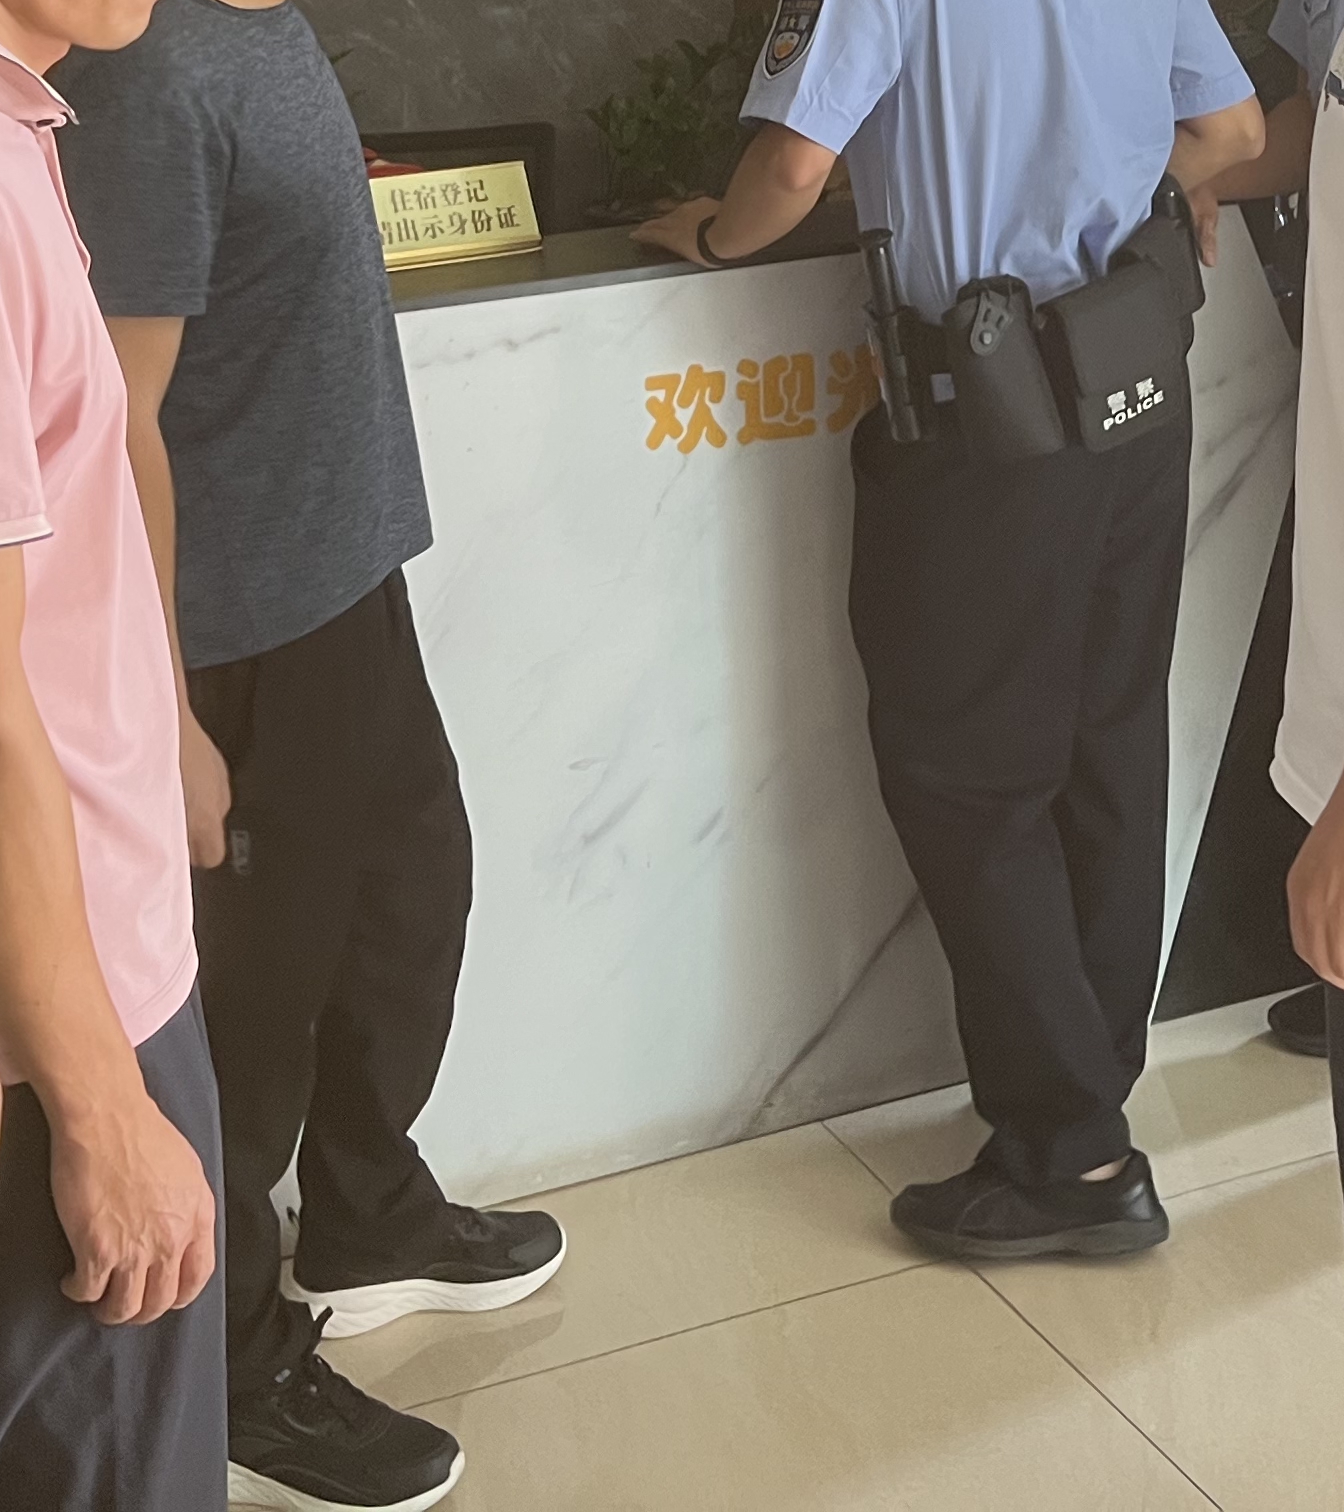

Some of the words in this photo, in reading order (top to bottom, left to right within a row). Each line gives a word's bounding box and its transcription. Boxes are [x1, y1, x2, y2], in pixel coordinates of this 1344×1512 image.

[390, 179, 489, 214] 住宿登记
[1103, 390, 1164, 431] POLICE
